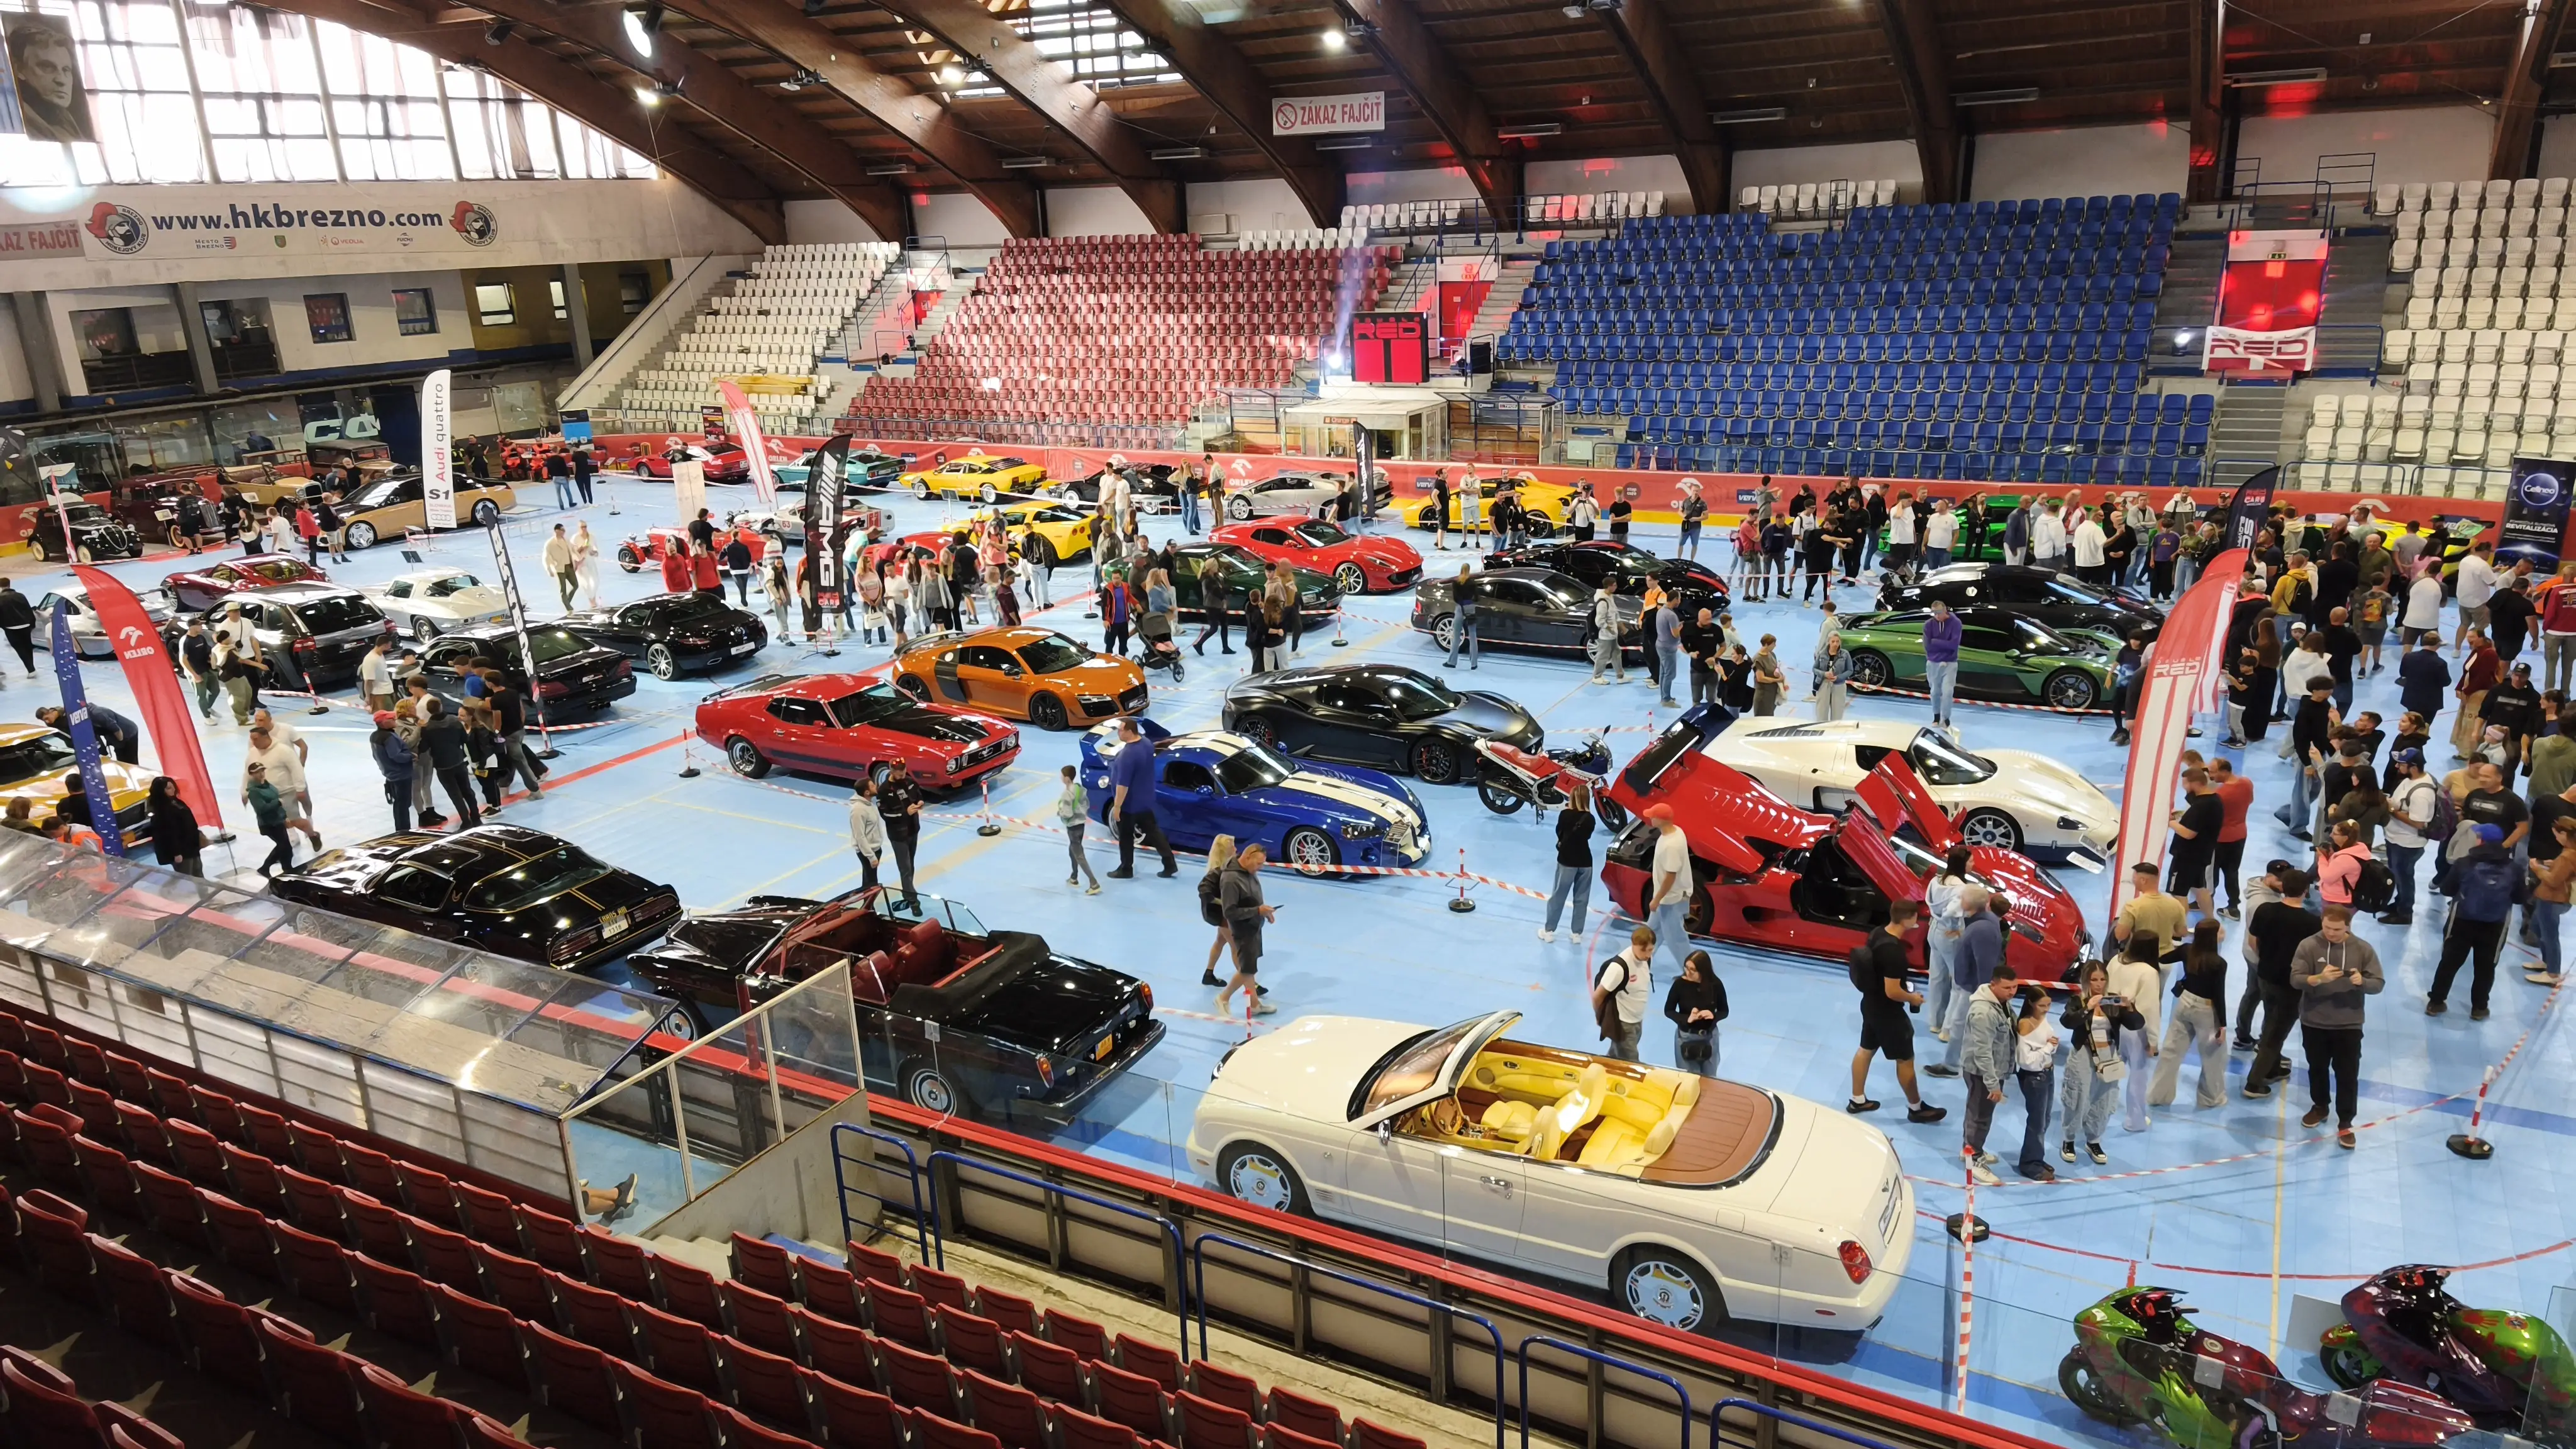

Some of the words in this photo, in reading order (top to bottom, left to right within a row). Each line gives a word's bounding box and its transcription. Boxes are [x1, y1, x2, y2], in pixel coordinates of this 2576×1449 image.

[1300, 100, 1337, 126] ZÁKAZ
[1341, 96, 1382, 123] FAJČIŤ
[151, 203, 443, 230] www.hkbrezno.com
[1353, 321, 1421, 340] RED
[2209, 338, 2308, 357] RED
[434, 383, 447, 442] quattro
[435, 447, 447, 482] Audi
[428, 489, 450, 500] S1
[782, 520, 791, 528] 63
[2506, 523, 2558, 533] REVITALIZÁCIA
[818, 493, 835, 587] AMG
[2153, 661, 2202, 677] RED
[69, 707, 89, 726] verva
